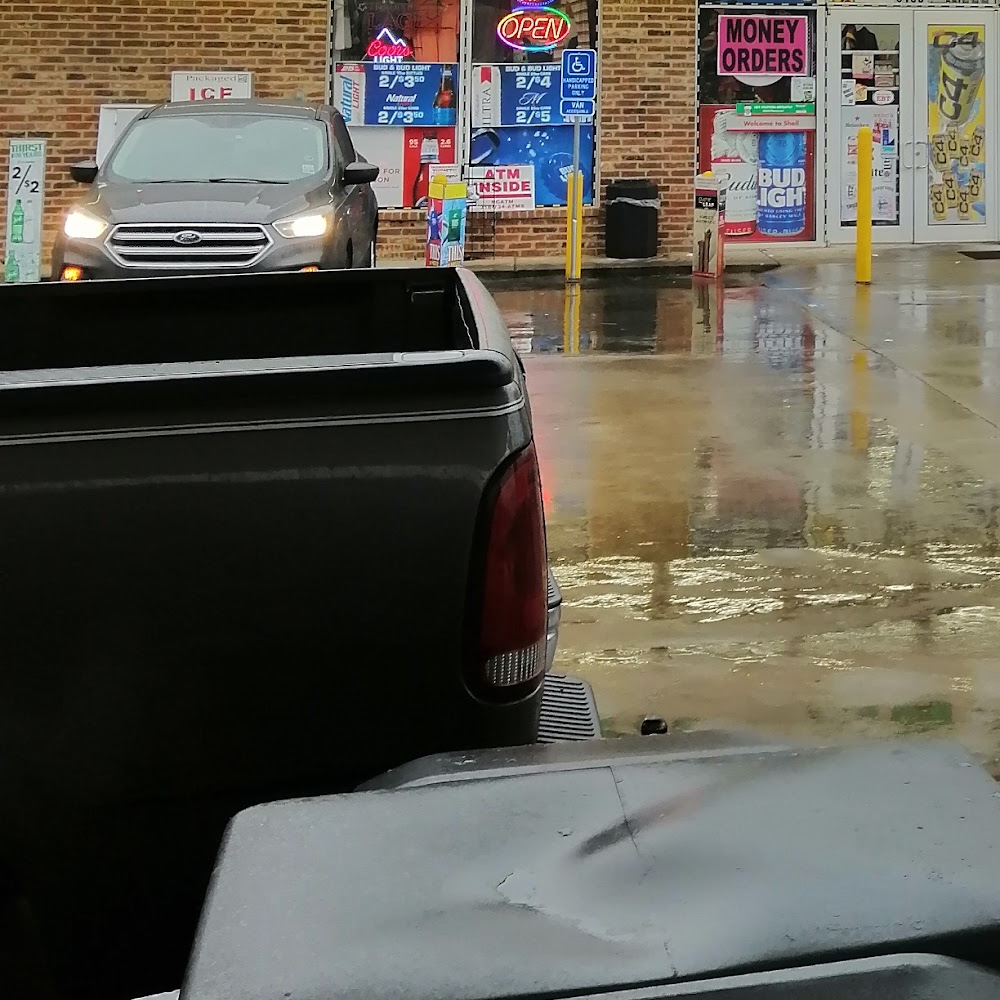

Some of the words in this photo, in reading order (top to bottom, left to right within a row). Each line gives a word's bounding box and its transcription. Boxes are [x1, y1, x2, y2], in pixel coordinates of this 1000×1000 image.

[501, 17, 564, 39] OPEN
[726, 18, 800, 44] MONEY
[367, 40, 413, 57] Coors
[933, 31, 979, 49] C4
[722, 47, 804, 73] ORDERS
[186, 75, 237, 83] Packaged
[352, 81, 360, 109] LIGHT
[385, 94, 418, 103] Natural
[571, 101, 585, 109] VAN
[940, 71, 969, 120] C4
[11, 143, 43, 153] THIRST
[936, 140, 947, 164] C4
[485, 168, 520, 180] ATM
[758, 167, 806, 188] BUD
[945, 178, 955, 201] C4
[934, 190, 945, 214] C4
[959, 191, 969, 213] C4
